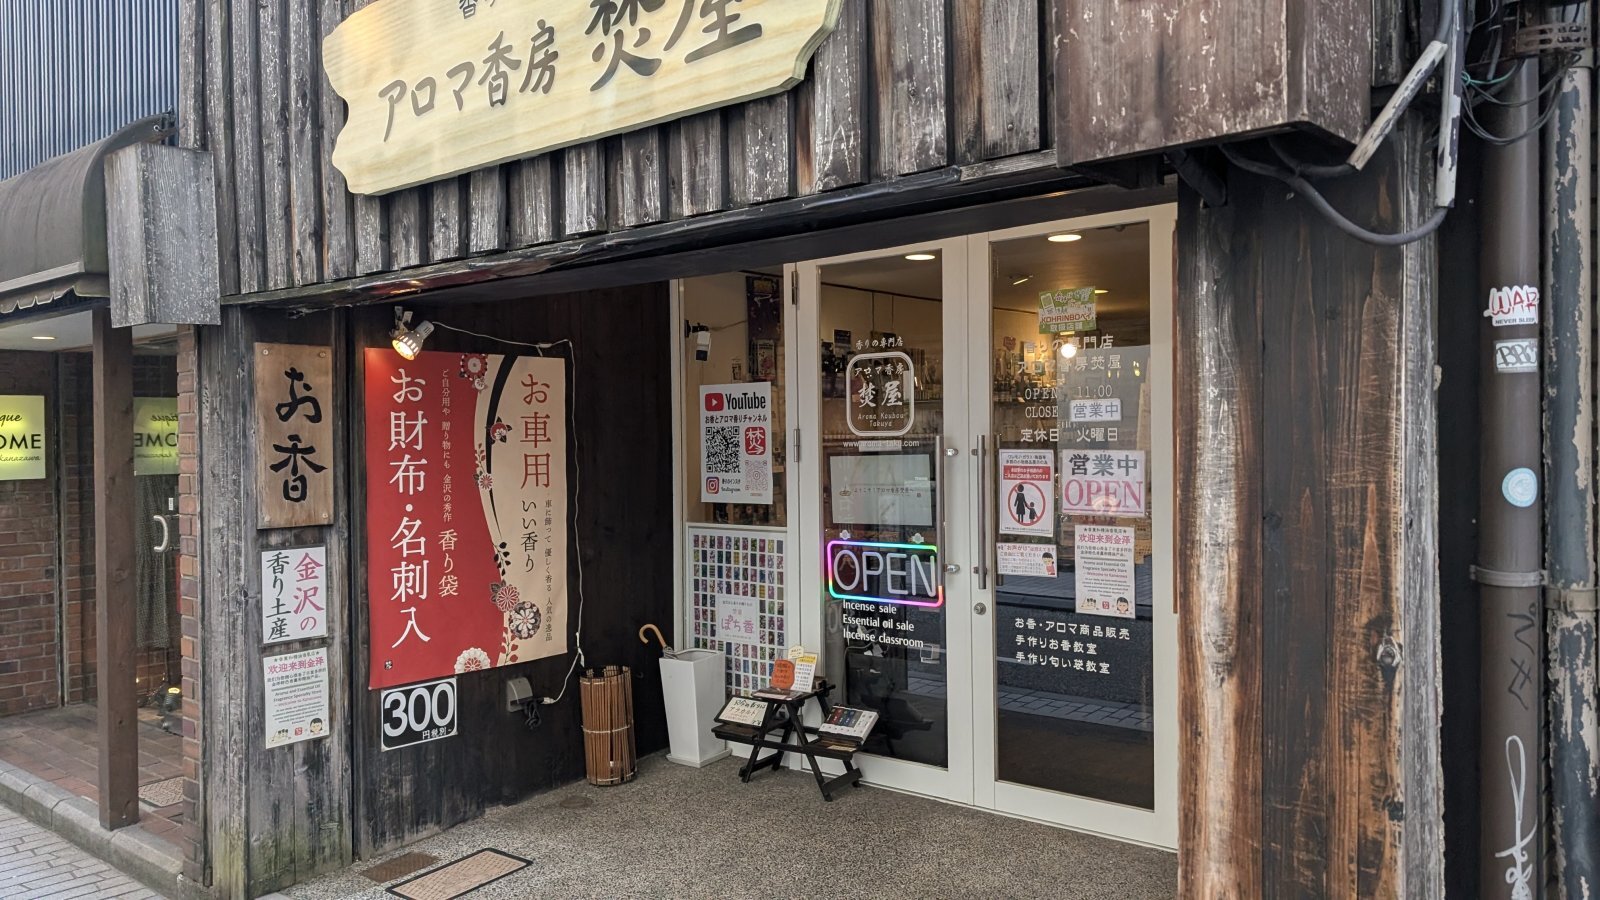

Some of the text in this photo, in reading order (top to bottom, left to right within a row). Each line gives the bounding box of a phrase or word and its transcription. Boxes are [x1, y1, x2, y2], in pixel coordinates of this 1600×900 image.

[377, 19, 559, 142] アロマ香房
[441, 369, 451, 416] ご自分用や
[725, 392, 766, 410] YouTube
[858, 380, 903, 408] 焚屋
[1024, 385, 1113, 400] OPEN 11:00
[705, 414, 768, 424] お香とアロマ香りチャンネル
[857, 412, 877, 420] Aroma
[1025, 406, 1058, 418] CLOSE
[1073, 401, 1119, 418] 営業中
[269, 367, 328, 502] お香
[520, 373, 552, 489] お車用
[1021, 427, 1118, 442] 定休日 火曜日
[1069, 453, 1138, 477] 営業中
[443, 474, 452, 522] 金沢の秀作
[1064, 479, 1143, 509] OPEN
[388, 368, 431, 648] お財布・名刺入
[521, 500, 538, 572] いい香り
[1079, 534, 1131, 545] 欢迎来到金泽
[438, 528, 459, 597] 香り袋
[833, 549, 937, 597] OPEN
[266, 552, 291, 640] 香り土産
[293, 552, 325, 631] 金沢の
[843, 600, 897, 615] Incense sale
[843, 614, 915, 632] Essential oil sale
[1015, 618, 1130, 640] お香・アロマ商品販売
[843, 628, 924, 648] Incense classroom
[1016, 634, 1097, 655] 手作りお香教室
[1016, 652, 1110, 674] 手作り匂い袋教室
[384, 683, 454, 737] 300
